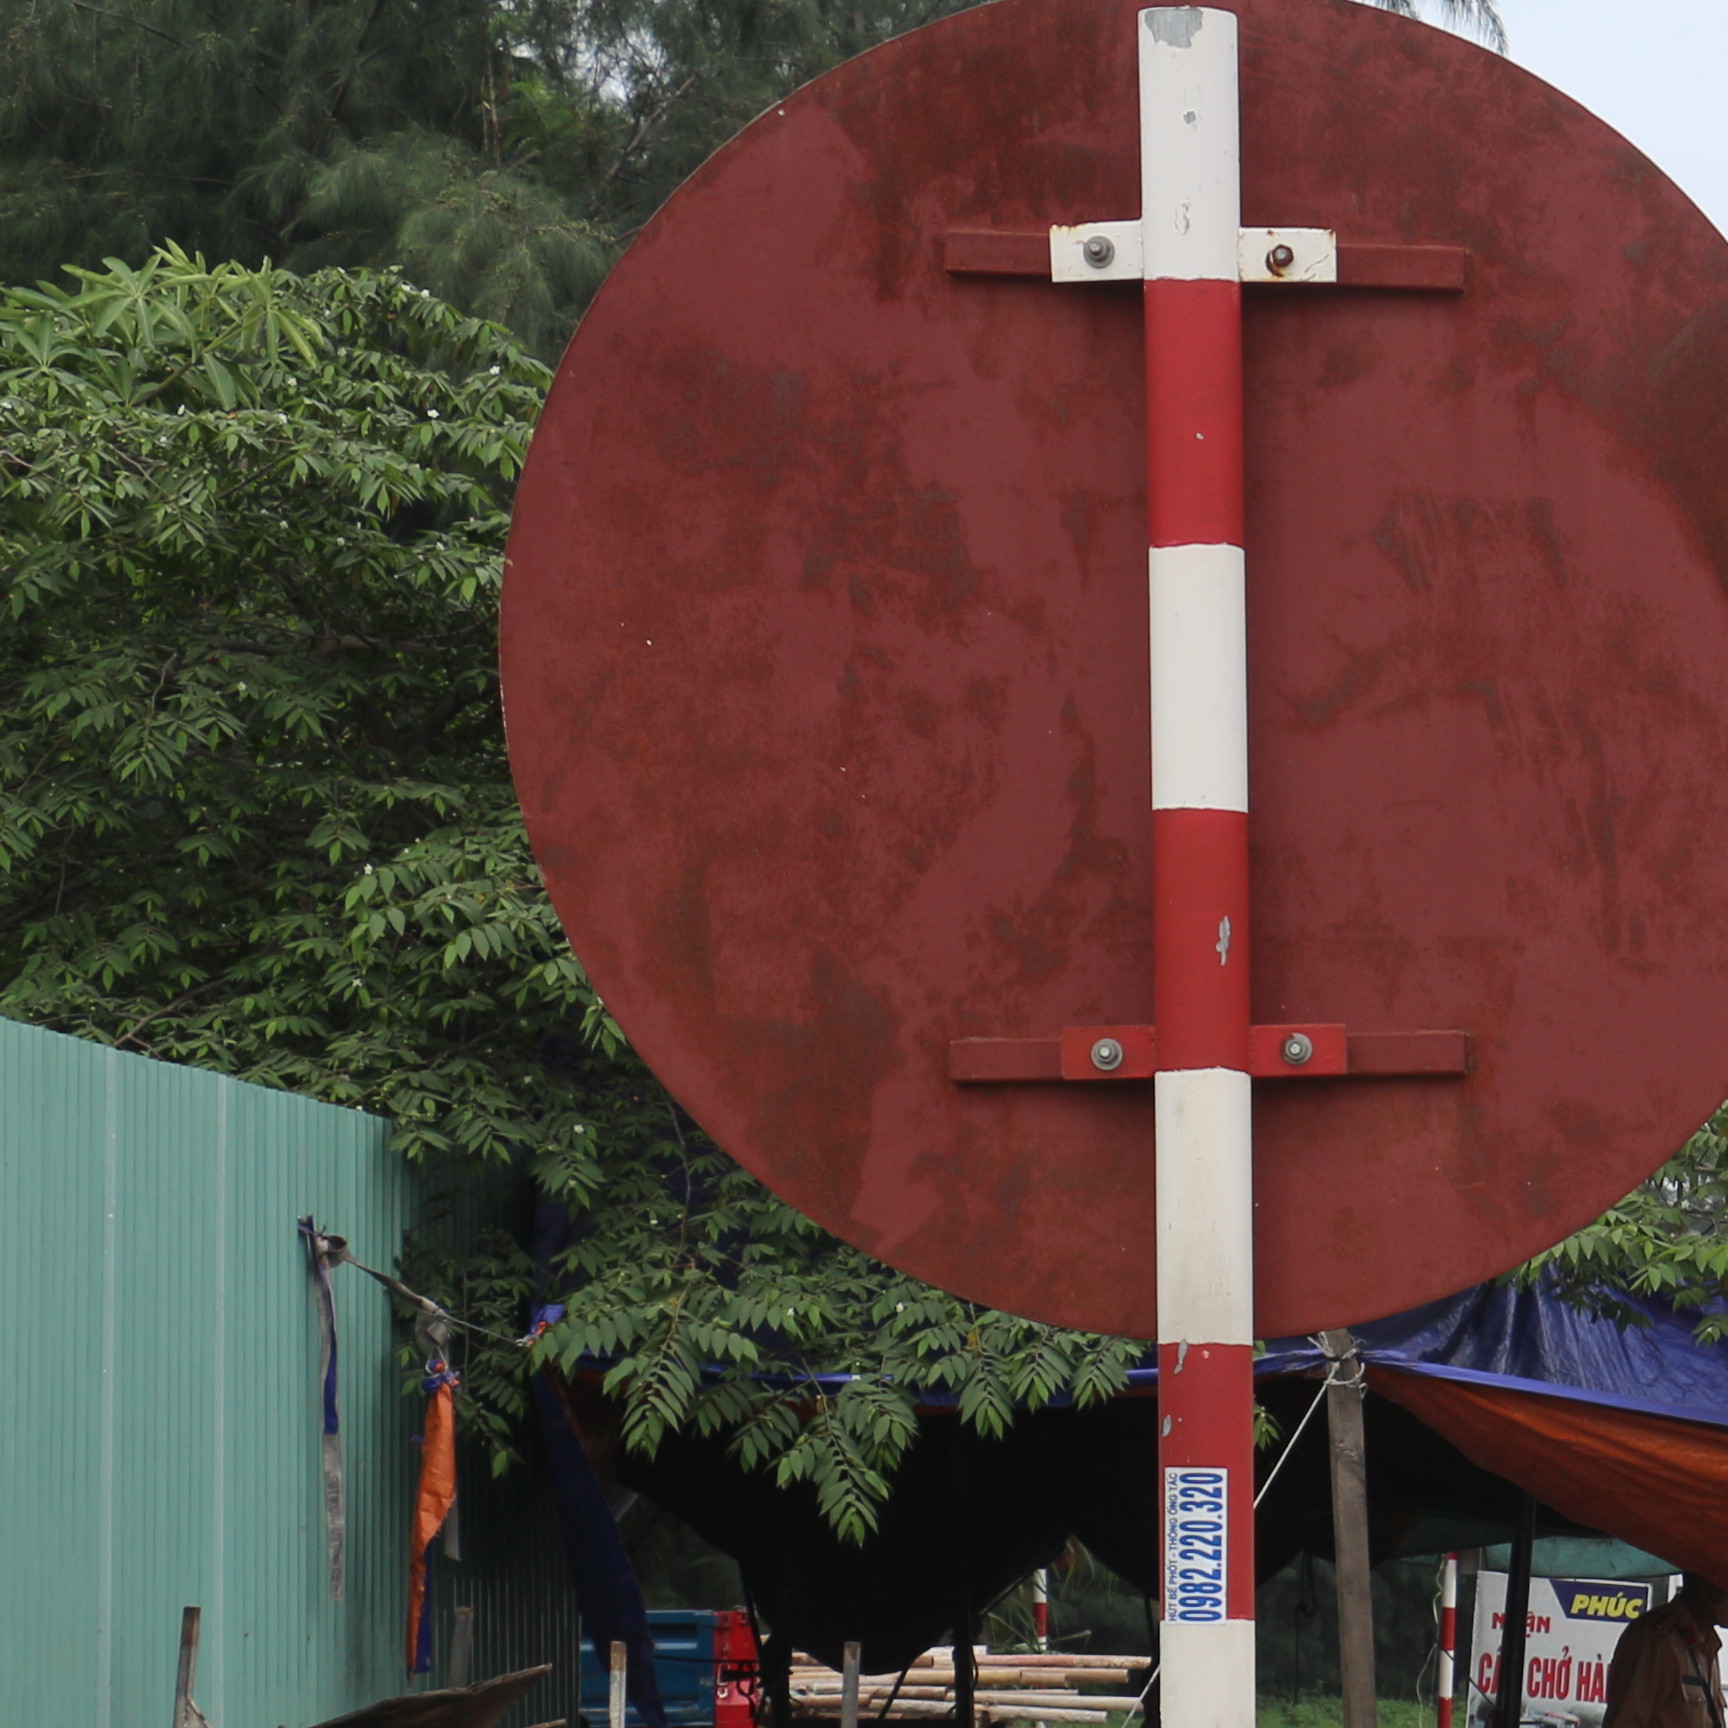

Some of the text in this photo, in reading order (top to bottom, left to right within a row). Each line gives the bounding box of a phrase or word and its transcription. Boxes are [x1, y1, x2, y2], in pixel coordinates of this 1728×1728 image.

[1167, 1517, 1178, 1552] THÔNG
[1178, 1472, 1224, 1622] 0982.220.320
[1166, 1559, 1178, 1586] PHỐT
[1168, 1602, 1178, 1622] HÚT
[1570, 1591, 1644, 1619] PHÚC
[1491, 1610, 1551, 1638] NẬN
[1527, 1645, 1573, 1700] CHỞ
[1576, 1653, 1610, 1703] HÀ
